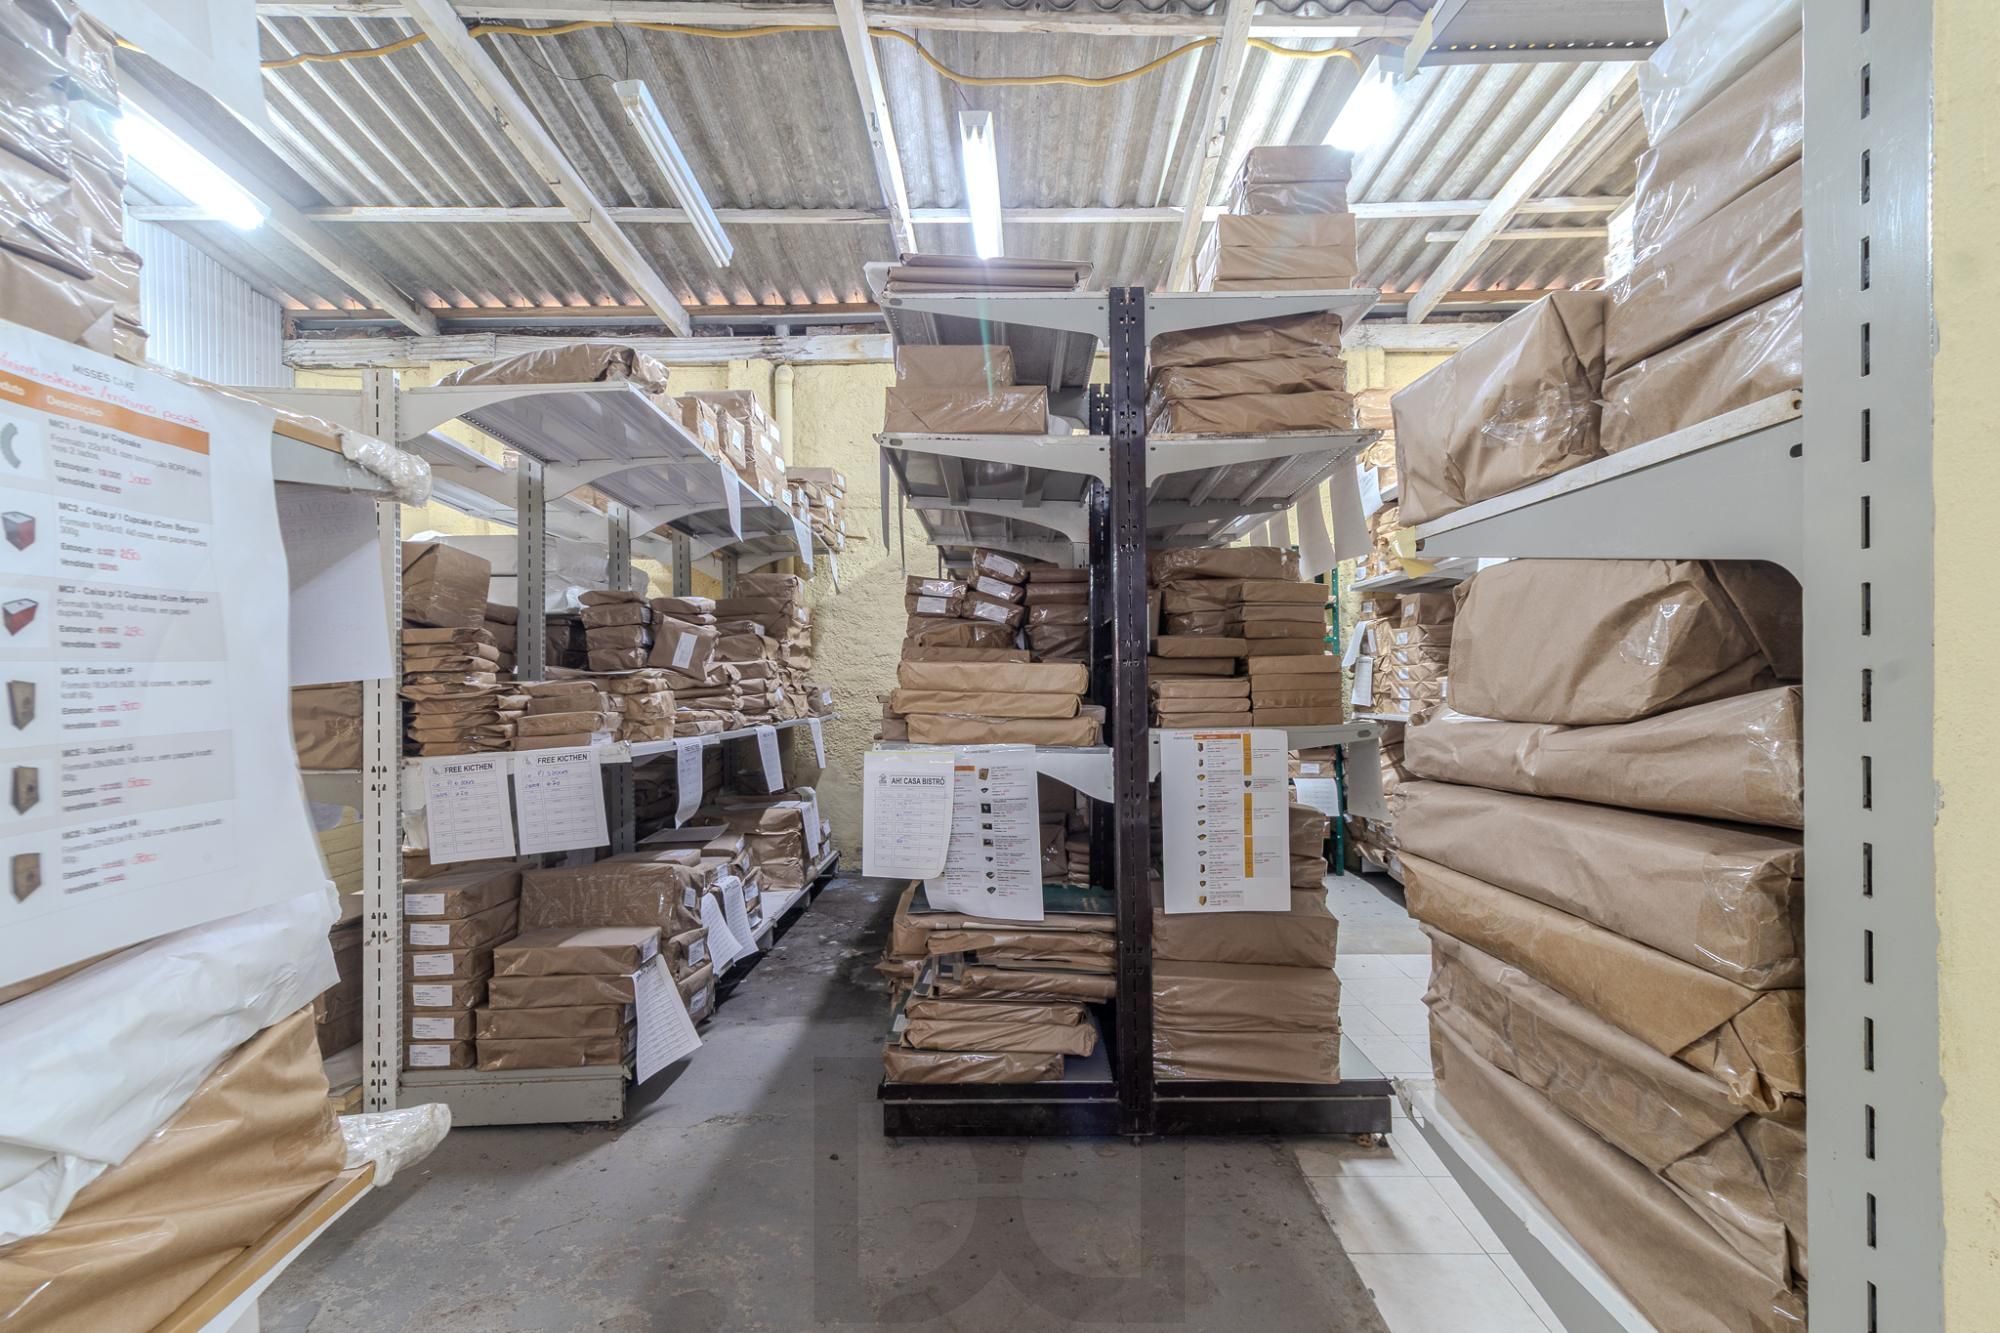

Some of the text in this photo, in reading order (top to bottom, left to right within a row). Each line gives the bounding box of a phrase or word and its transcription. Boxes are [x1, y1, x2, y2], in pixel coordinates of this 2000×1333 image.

[72, 364, 111, 383] MISSES
[58, 502, 79, 513] MC2
[537, 753, 588, 764] FREE KICTHEN
[444, 763, 493, 774] FREE KICTHEN
[903, 777, 921, 785] CASA
[922, 776, 945, 785] BISTRÓ
